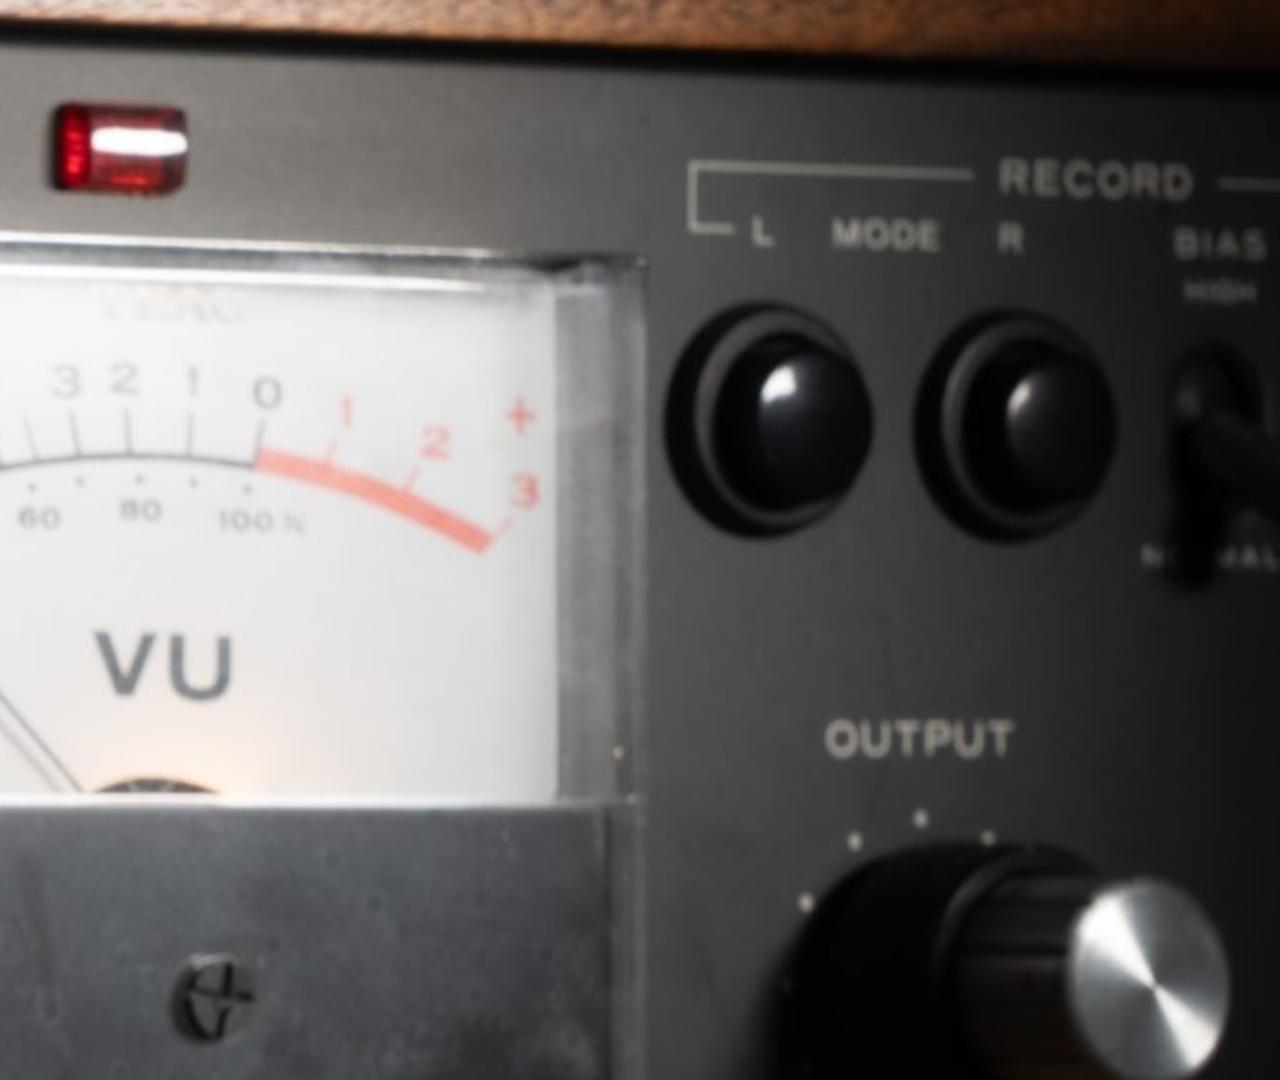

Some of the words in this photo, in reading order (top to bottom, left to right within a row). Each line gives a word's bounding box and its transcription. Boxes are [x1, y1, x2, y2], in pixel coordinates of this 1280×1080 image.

[997, 156, 1195, 199] RECORD
[750, 214, 776, 248] L
[831, 217, 942, 253] MODE
[997, 221, 1025, 254] R
[1172, 226, 1268, 261] BIAS
[51, 364, 83, 399] 3
[108, 361, 140, 396] 2
[185, 365, 201, 397] 1
[252, 376, 283, 411] 0
[336, 393, 354, 428] 1
[419, 426, 454, 462] 2
[510, 472, 540, 510] 3
[17, 505, 62, 531] 60
[119, 499, 163, 523] 80
[92, 629, 235, 703] VU
[823, 718, 1017, 761] OUTPUT
